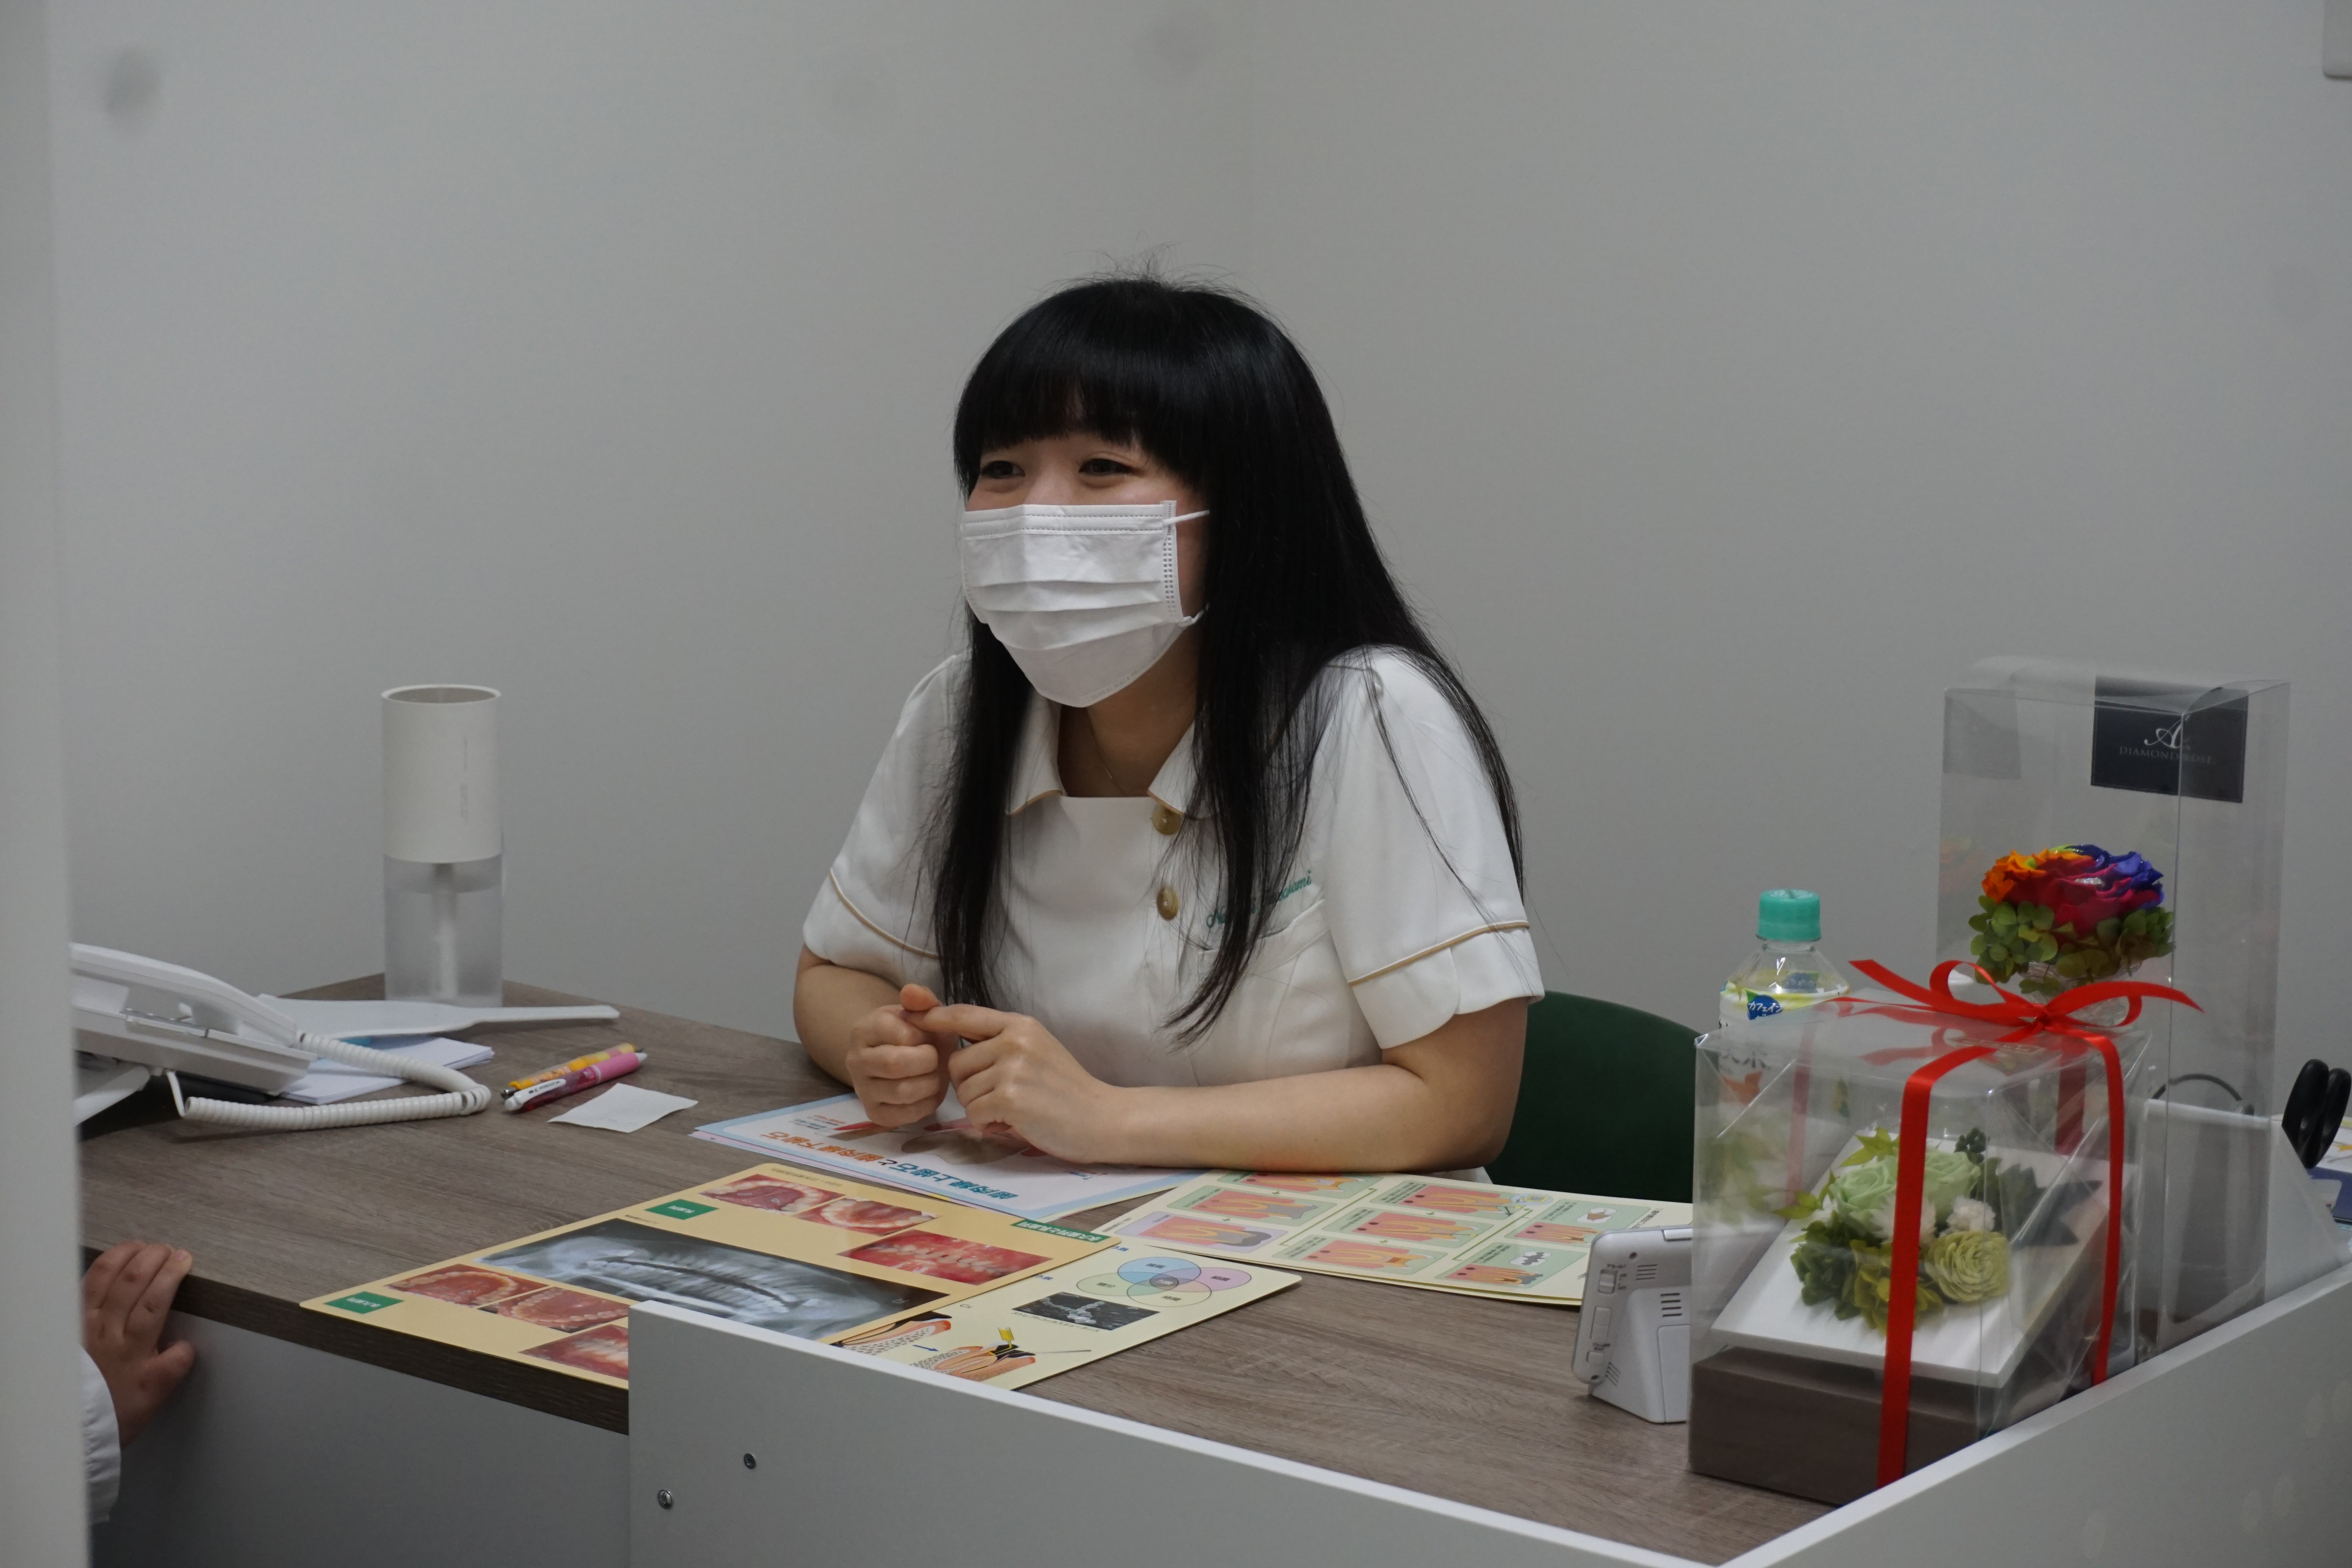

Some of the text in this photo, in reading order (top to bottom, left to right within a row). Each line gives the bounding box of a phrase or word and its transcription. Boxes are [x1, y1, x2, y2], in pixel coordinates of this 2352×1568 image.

[2119, 746, 2180, 760] DIAMOND
[1748, 1001, 1784, 1013] カフェイン
